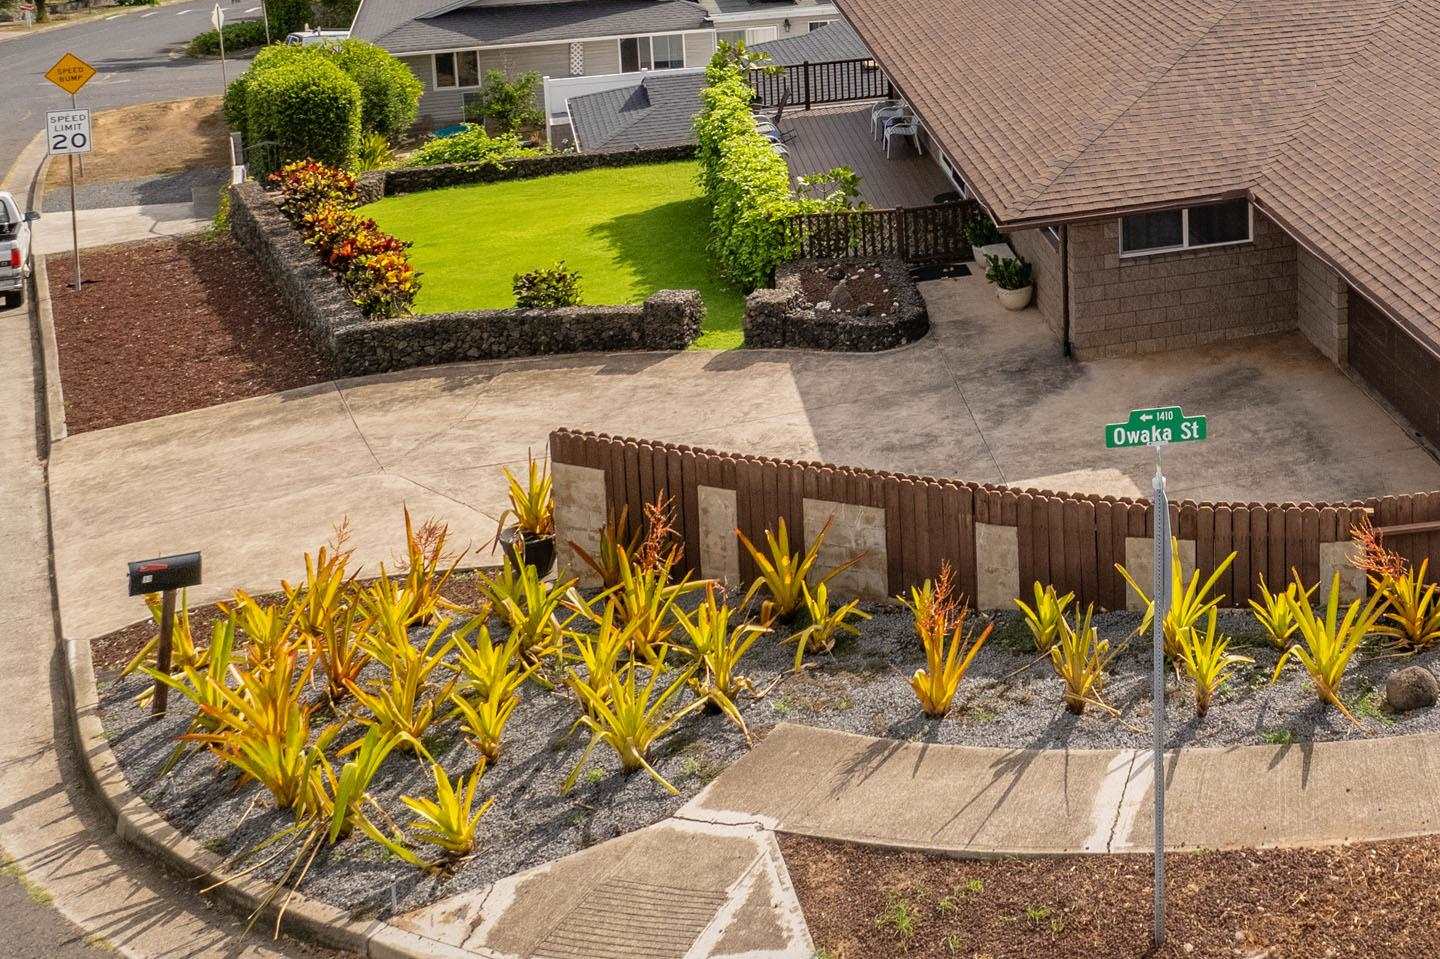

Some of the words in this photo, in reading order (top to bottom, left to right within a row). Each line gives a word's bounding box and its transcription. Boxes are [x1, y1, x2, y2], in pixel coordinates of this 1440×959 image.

[50, 114, 86, 123] SPEED
[55, 123, 81, 131] LIMIT
[52, 133, 87, 150] 20
[1156, 411, 1174, 421] 1410
[1113, 425, 1172, 445] Owaka
[1180, 421, 1199, 439] St
